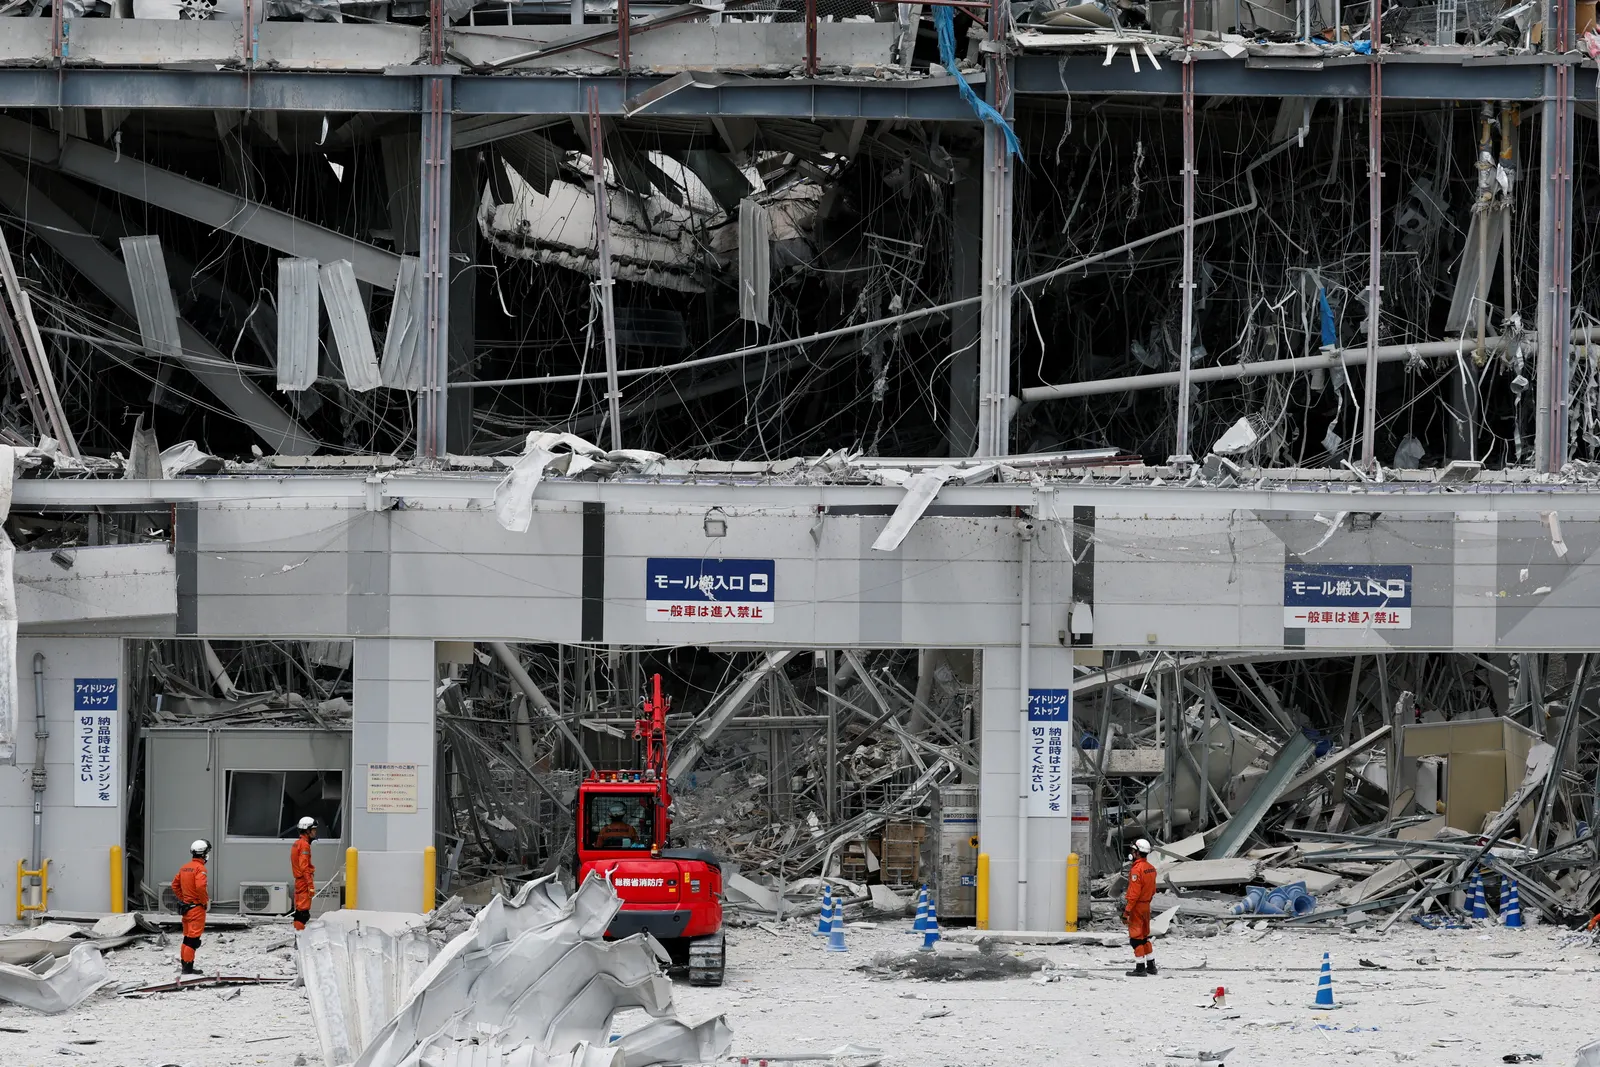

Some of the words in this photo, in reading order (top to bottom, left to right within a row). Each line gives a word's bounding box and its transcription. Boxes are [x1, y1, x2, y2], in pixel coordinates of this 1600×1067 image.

[1292, 580, 1380, 596] モール搬入口
[657, 605, 763, 619] 一般車は進入禁止
[1294, 611, 1400, 624] 一般車は進入禁止
[76, 684, 116, 693] アイドリング
[82, 696, 110, 705] ストップ
[1028, 695, 1067, 704] アイドリング
[1033, 706, 1061, 716] ストップ
[80, 716, 94, 782] 切ってください
[97, 716, 111, 801] 納品時はエンジンを
[1031, 727, 1045, 792] 切ってください
[1048, 727, 1062, 812] 納品時はエンジンを
